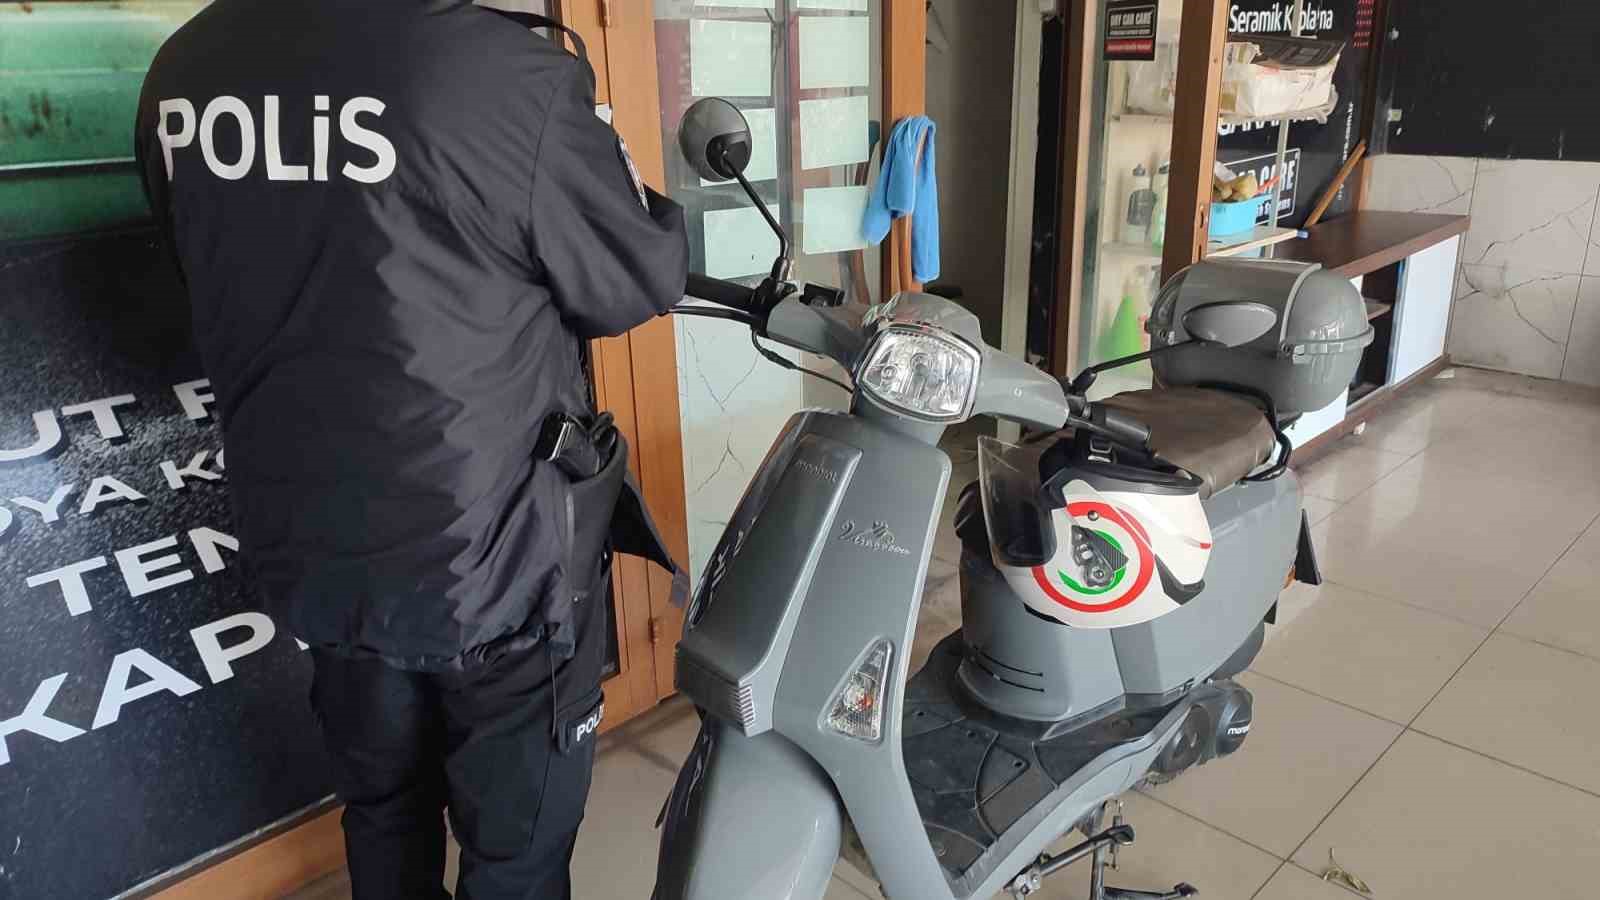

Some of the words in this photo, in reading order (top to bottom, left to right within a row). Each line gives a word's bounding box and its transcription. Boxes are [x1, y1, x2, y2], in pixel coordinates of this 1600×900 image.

[1229, 1, 1282, 33] Seramik
[160, 448, 225, 490] K
[0, 612, 309, 765] KAP
